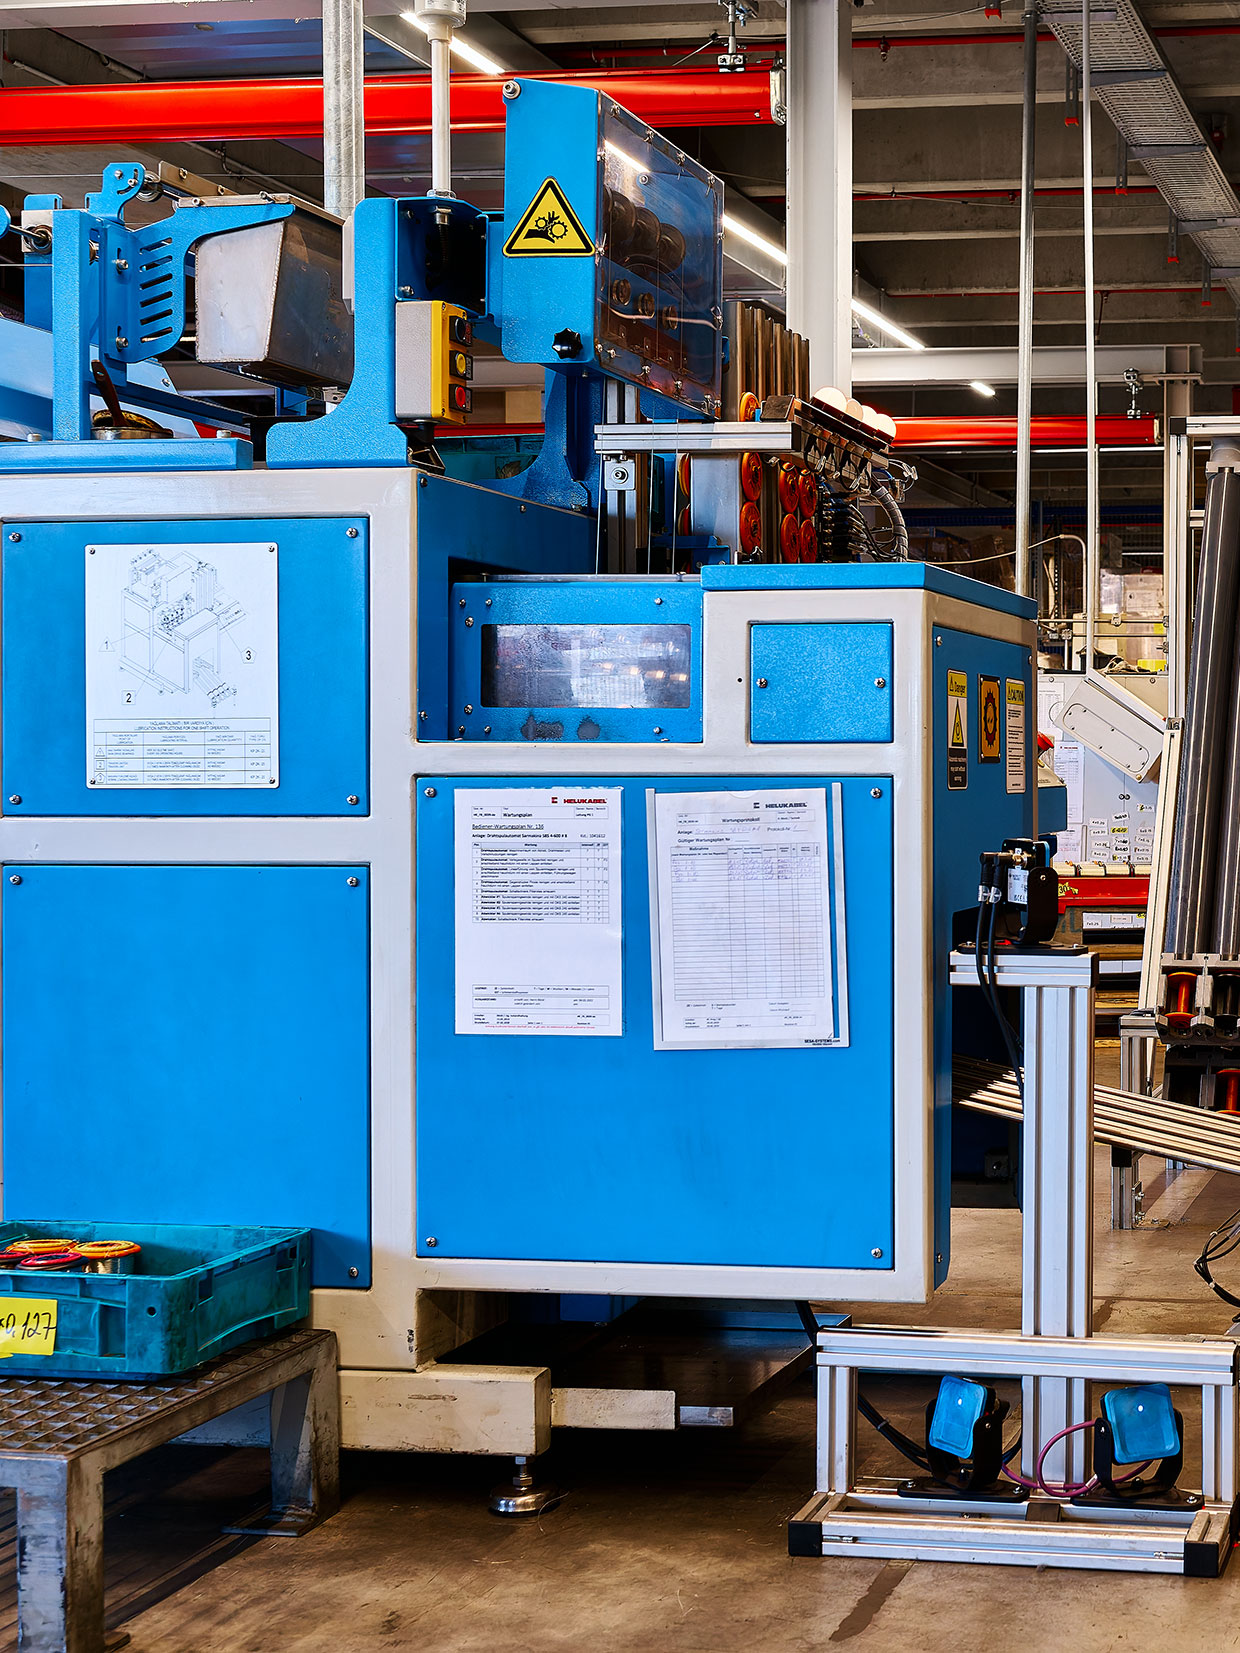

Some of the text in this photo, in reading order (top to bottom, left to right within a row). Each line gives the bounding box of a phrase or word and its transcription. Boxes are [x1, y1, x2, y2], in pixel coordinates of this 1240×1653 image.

[104, 641, 109, 650] 1
[246, 651, 252, 660] 3
[125, 693, 132, 703] 2
